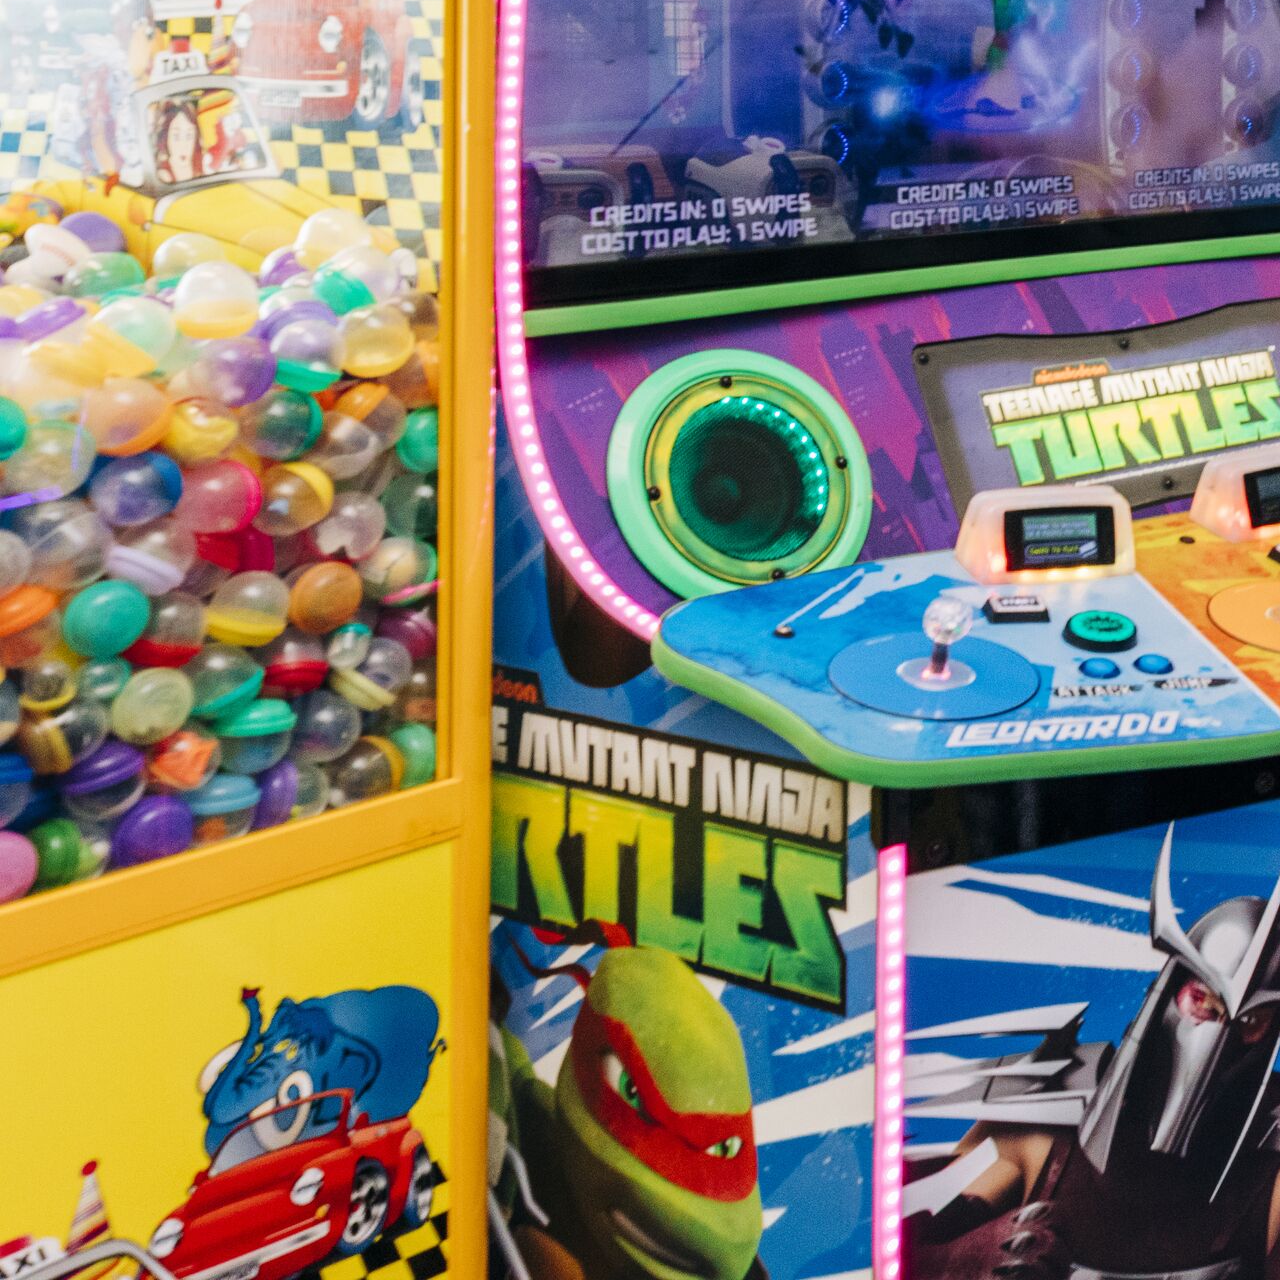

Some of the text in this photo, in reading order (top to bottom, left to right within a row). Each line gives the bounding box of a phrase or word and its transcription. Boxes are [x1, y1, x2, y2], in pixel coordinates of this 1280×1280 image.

[897, 183, 966, 204] CREDITS
[968, 180, 989, 199] IN:
[1010, 176, 1074, 196] SWIPES
[1135, 167, 1191, 188] CREDITS
[1227, 162, 1280, 181] SWIPES
[590, 201, 677, 227] CREDITS
[680, 200, 706, 221] IN:
[732, 193, 812, 217] SWIPES
[890, 209, 936, 229] COST
[938, 206, 960, 225] TO
[1013, 202, 1021, 219] 1
[1024, 198, 1080, 217] SWIPE
[1129, 191, 1166, 210] COST
[581, 231, 639, 255] COST
[642, 228, 670, 251] TO
[737, 223, 747, 242] 1
[752, 218, 818, 240] SWIPE
[982, 350, 1275, 423] TEENAGE MUTANT NINJA
[1058, 683, 1133, 697] ATTACK
[945, 709, 1181, 748] LEONARDO
[517, 711, 697, 808] MUTANT
[702, 751, 844, 843] NINJA
[490, 773, 845, 1005] RTLES
